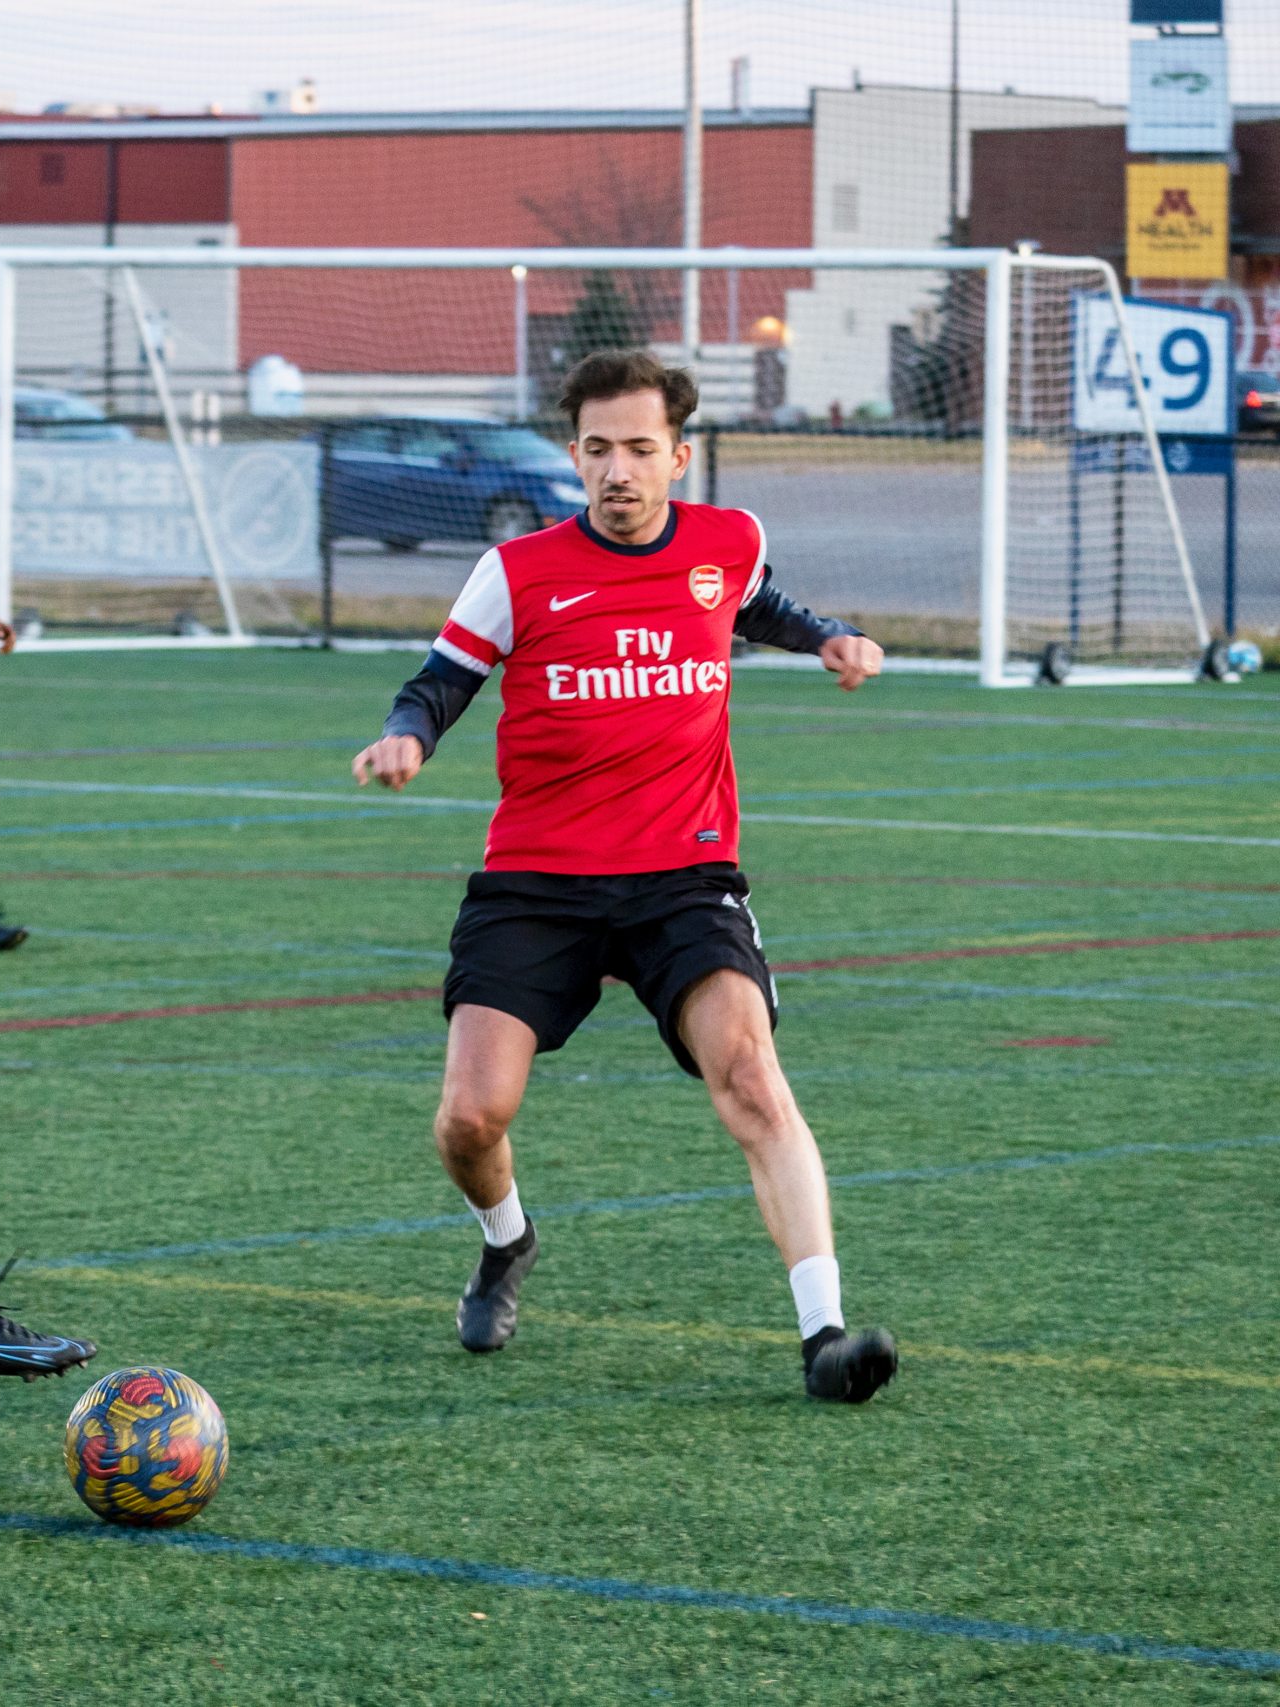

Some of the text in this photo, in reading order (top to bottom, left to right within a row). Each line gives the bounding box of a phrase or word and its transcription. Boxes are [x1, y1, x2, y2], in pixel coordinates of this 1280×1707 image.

[1154, 187, 1196, 217] M
[1137, 221, 1213, 239] HEALTH
[1093, 328, 1211, 410] 49
[614, 628, 673, 661] Fly
[545, 658, 727, 700] Emirates
